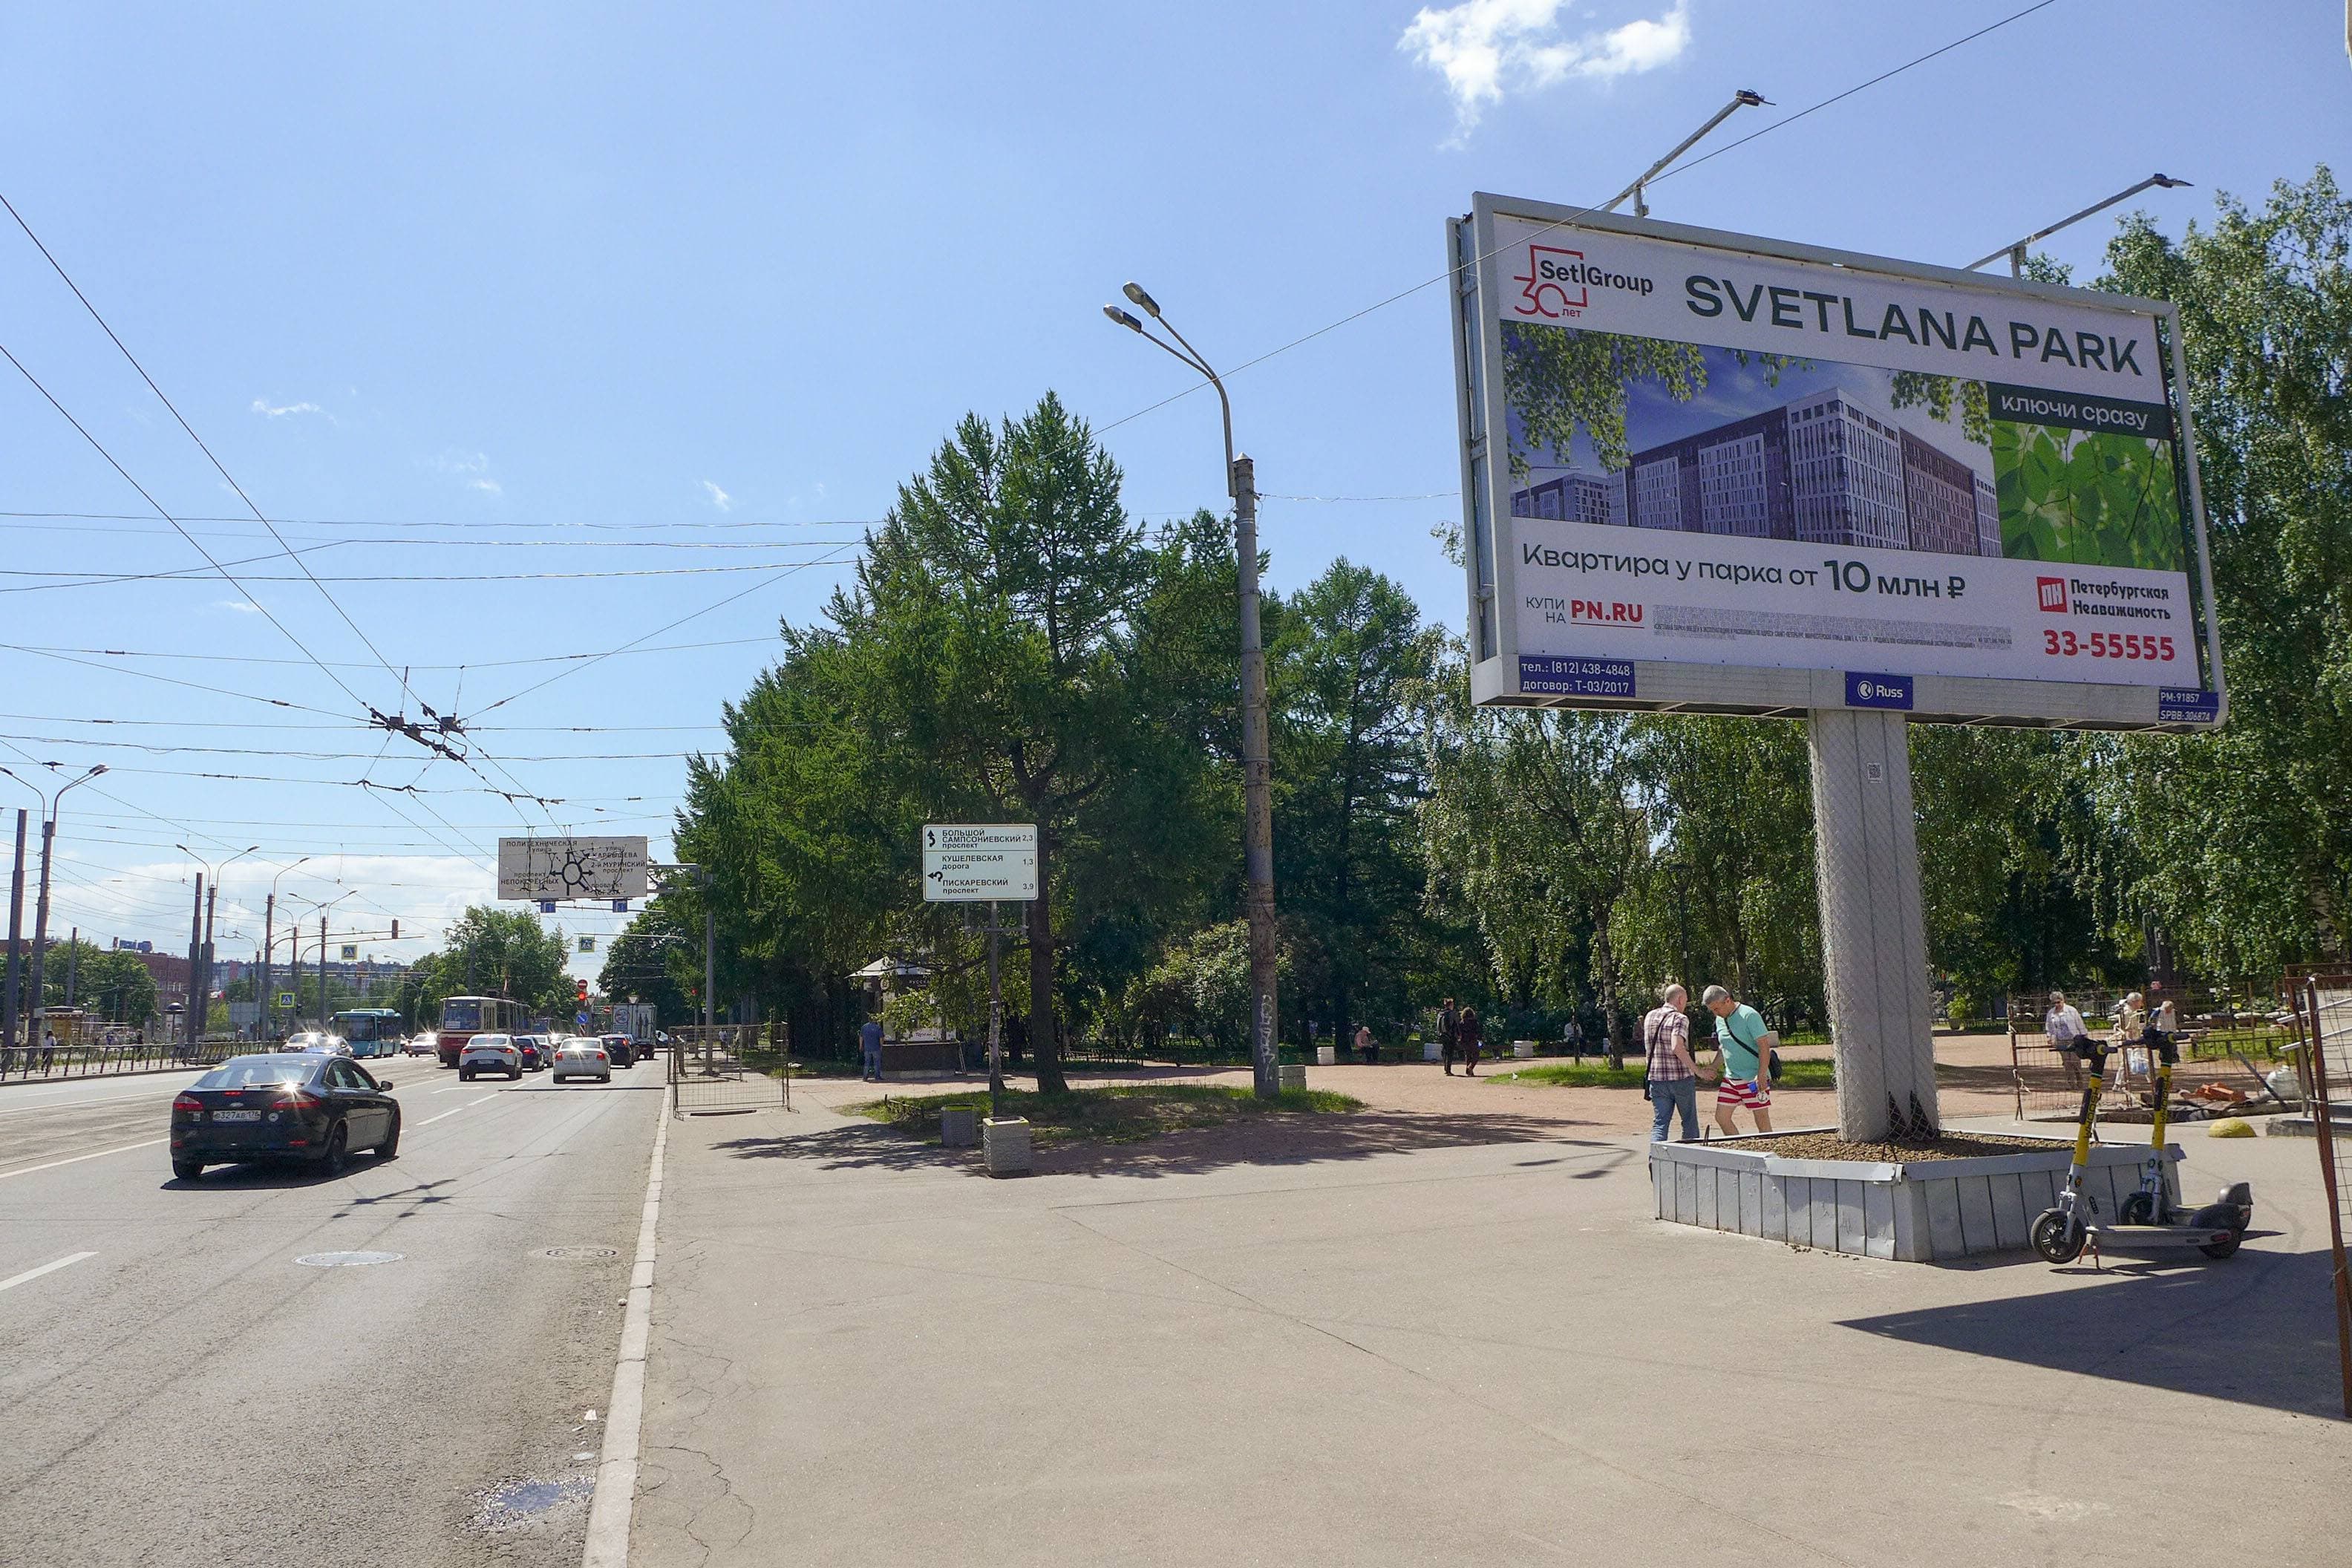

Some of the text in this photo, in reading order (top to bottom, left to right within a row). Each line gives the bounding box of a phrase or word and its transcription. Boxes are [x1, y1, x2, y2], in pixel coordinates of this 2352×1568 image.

[1561, 307, 1581, 318] лет
[1685, 275, 2143, 376] SVETLANA PARK
[2001, 395, 2149, 431] ключи сразу
[1523, 543, 1669, 578] Квартира
[1675, 560, 1692, 581] у
[1699, 561, 1783, 585] парка
[1788, 569, 1819, 587] от
[1823, 559, 1871, 593] 10
[1877, 575, 1940, 598] млн
[2070, 578, 2169, 600] Петербургская
[1526, 596, 1565, 610] КУПИ
[2072, 599, 2172, 620] Недвижимость
[1546, 612, 1567, 624] НА
[1571, 600, 1644, 622] PN.RU
[2042, 629, 2175, 662] 33-55555
[1520, 661, 1631, 676] тел.: (812) 438-4848
[1523, 681, 1573, 693] договор:
[1876, 685, 1904, 699] Russ
[942, 829, 984, 837] БОЛЬШОЙ
[942, 878, 1008, 886] ПИСКАРЕВСКИЙ
